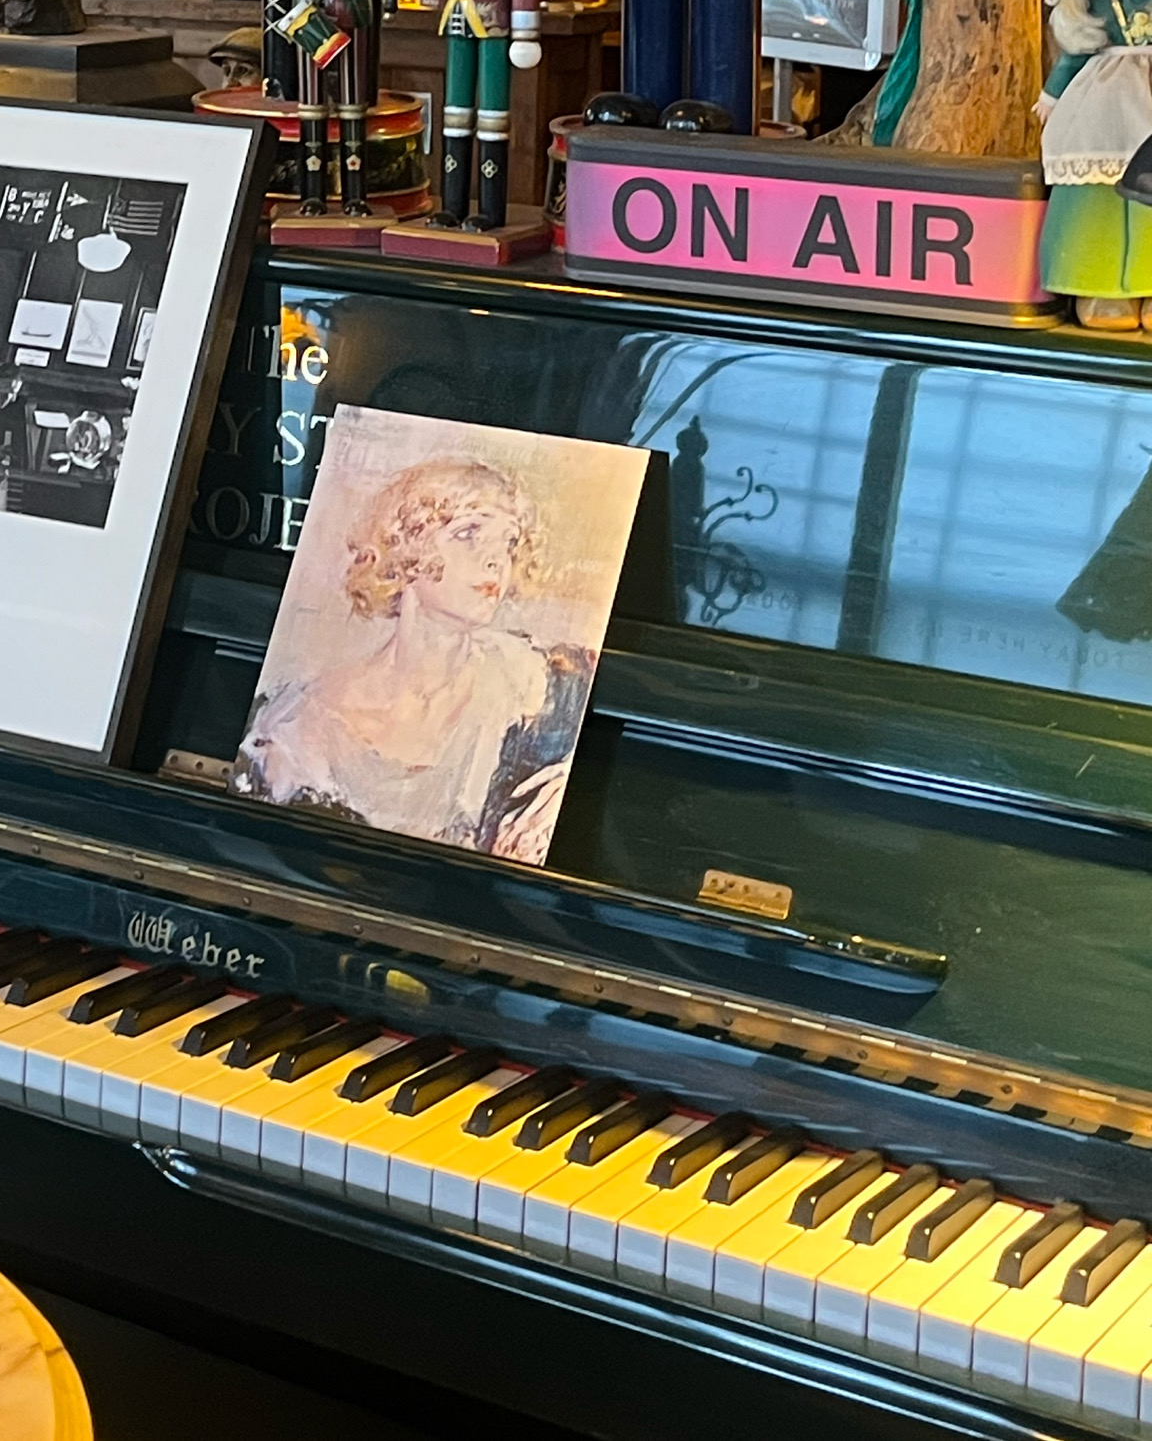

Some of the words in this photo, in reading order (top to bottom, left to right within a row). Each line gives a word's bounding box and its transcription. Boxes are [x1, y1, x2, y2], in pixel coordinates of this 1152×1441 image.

[612, 177, 749, 262] ON
[792, 195, 974, 286] AIR
[191, 486, 310, 551] OJE
[128, 911, 265, 978] Weber
